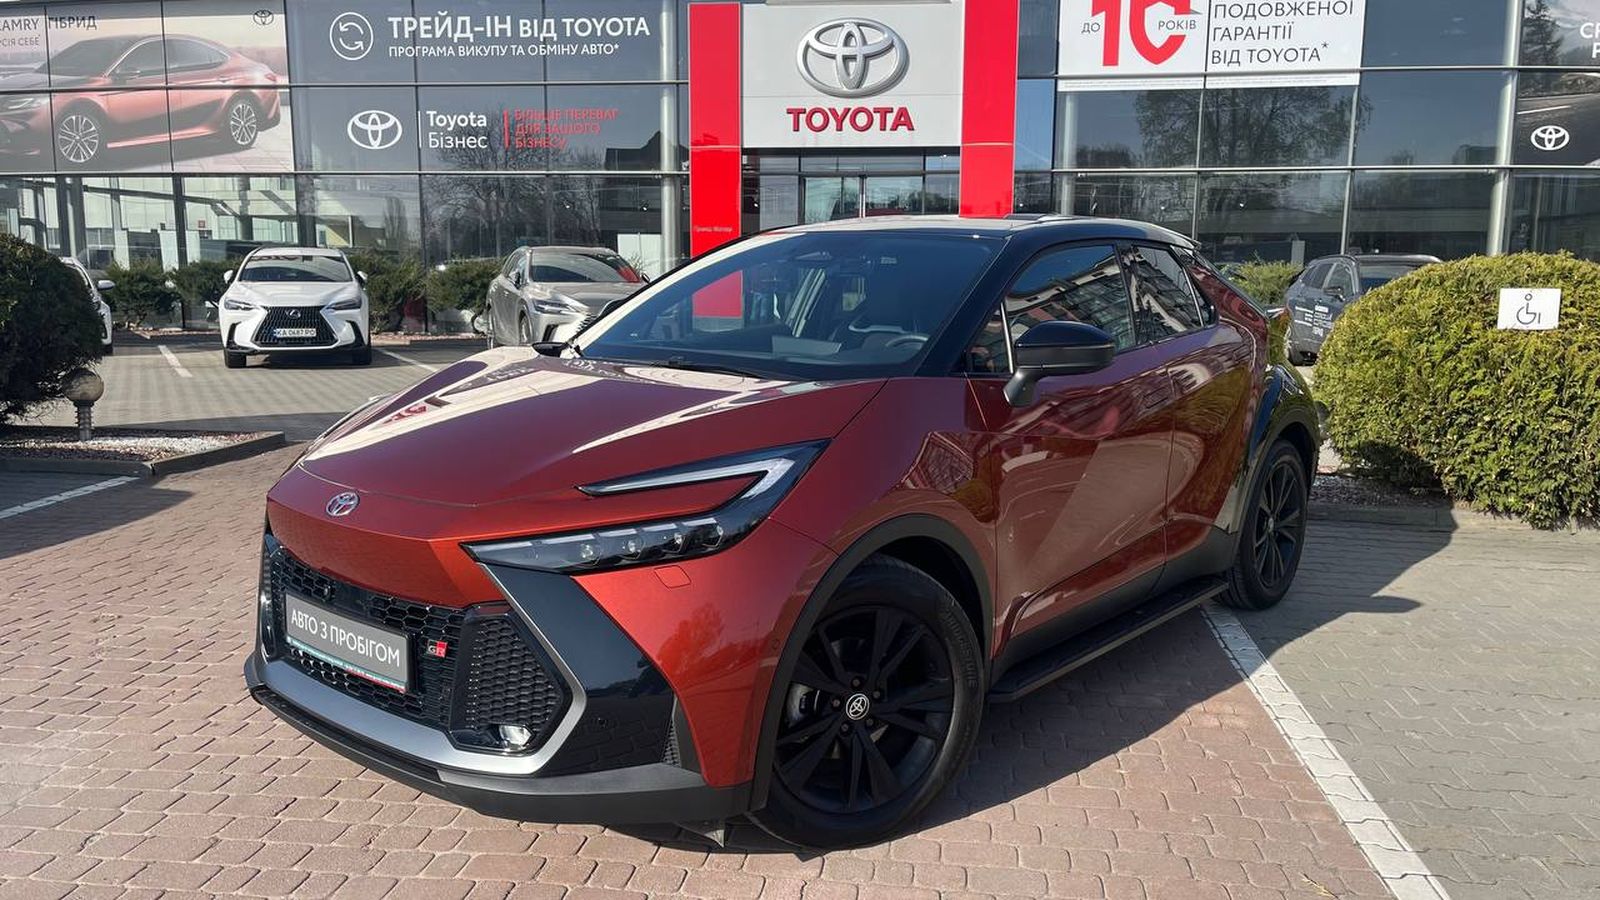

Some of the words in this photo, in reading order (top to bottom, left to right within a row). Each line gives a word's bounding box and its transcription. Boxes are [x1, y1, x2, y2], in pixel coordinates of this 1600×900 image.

[0, 18, 40, 32] AMRY
[48, 16, 98, 31] ГІБРИД
[387, 12, 512, 42] ТРЕЙД-ІН
[519, 18, 558, 41] ВІД
[562, 17, 651, 38] TOYOTA
[1081, 22, 1101, 34] ДО
[1157, 20, 1197, 31] РОКІВ
[1212, 21, 1294, 42] ГАРАНТІЇ
[388, 45, 457, 58] ПРОГРАМА
[458, 44, 508, 57] ВИКУПУ
[510, 45, 527, 56] ТА
[528, 43, 580, 56] ОБМІНУ
[1211, 50, 1241, 67] ВІД
[426, 111, 488, 131] Toyota
[786, 107, 915, 133] TOYOTA
[428, 132, 489, 150] Бізнес
[291, 608, 318, 635] АВТО
[320, 621, 328, 640] З
[330, 624, 401, 668] ПРОБІГОМ
